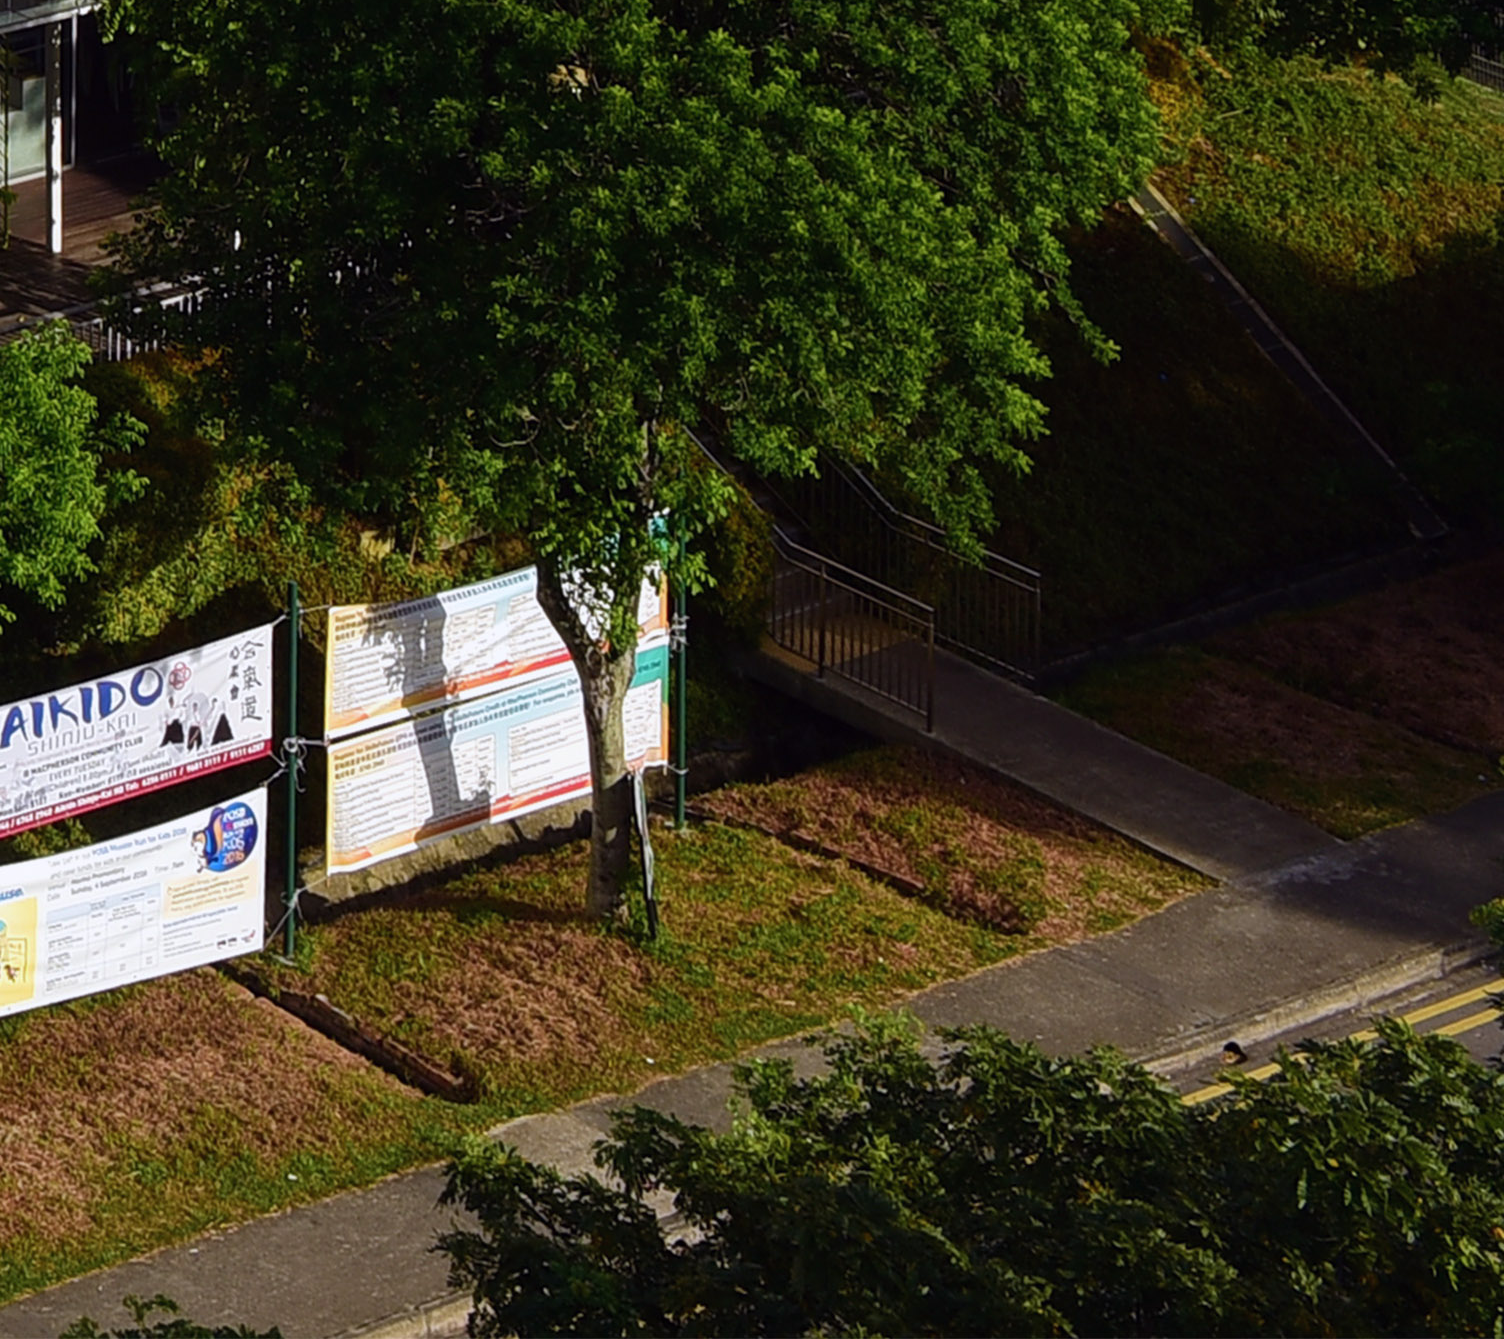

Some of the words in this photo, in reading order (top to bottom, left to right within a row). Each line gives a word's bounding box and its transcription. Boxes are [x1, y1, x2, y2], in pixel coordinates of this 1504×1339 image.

[538, 682, 564, 700] Community
[0, 666, 164, 749] AIKIDO
[27, 712, 137, 757] SHINJU-KAI
[30, 752, 79, 776] MACPHERSON
[80, 741, 123, 762] COMMUNITY
[124, 734, 144, 747] CLUB
[48, 766, 71, 782] EVERY
[73, 757, 105, 775] TUESDAY
[224, 807, 246, 822] POSB
[157, 831, 172, 841] Kids
[99, 874, 131, 889] September
